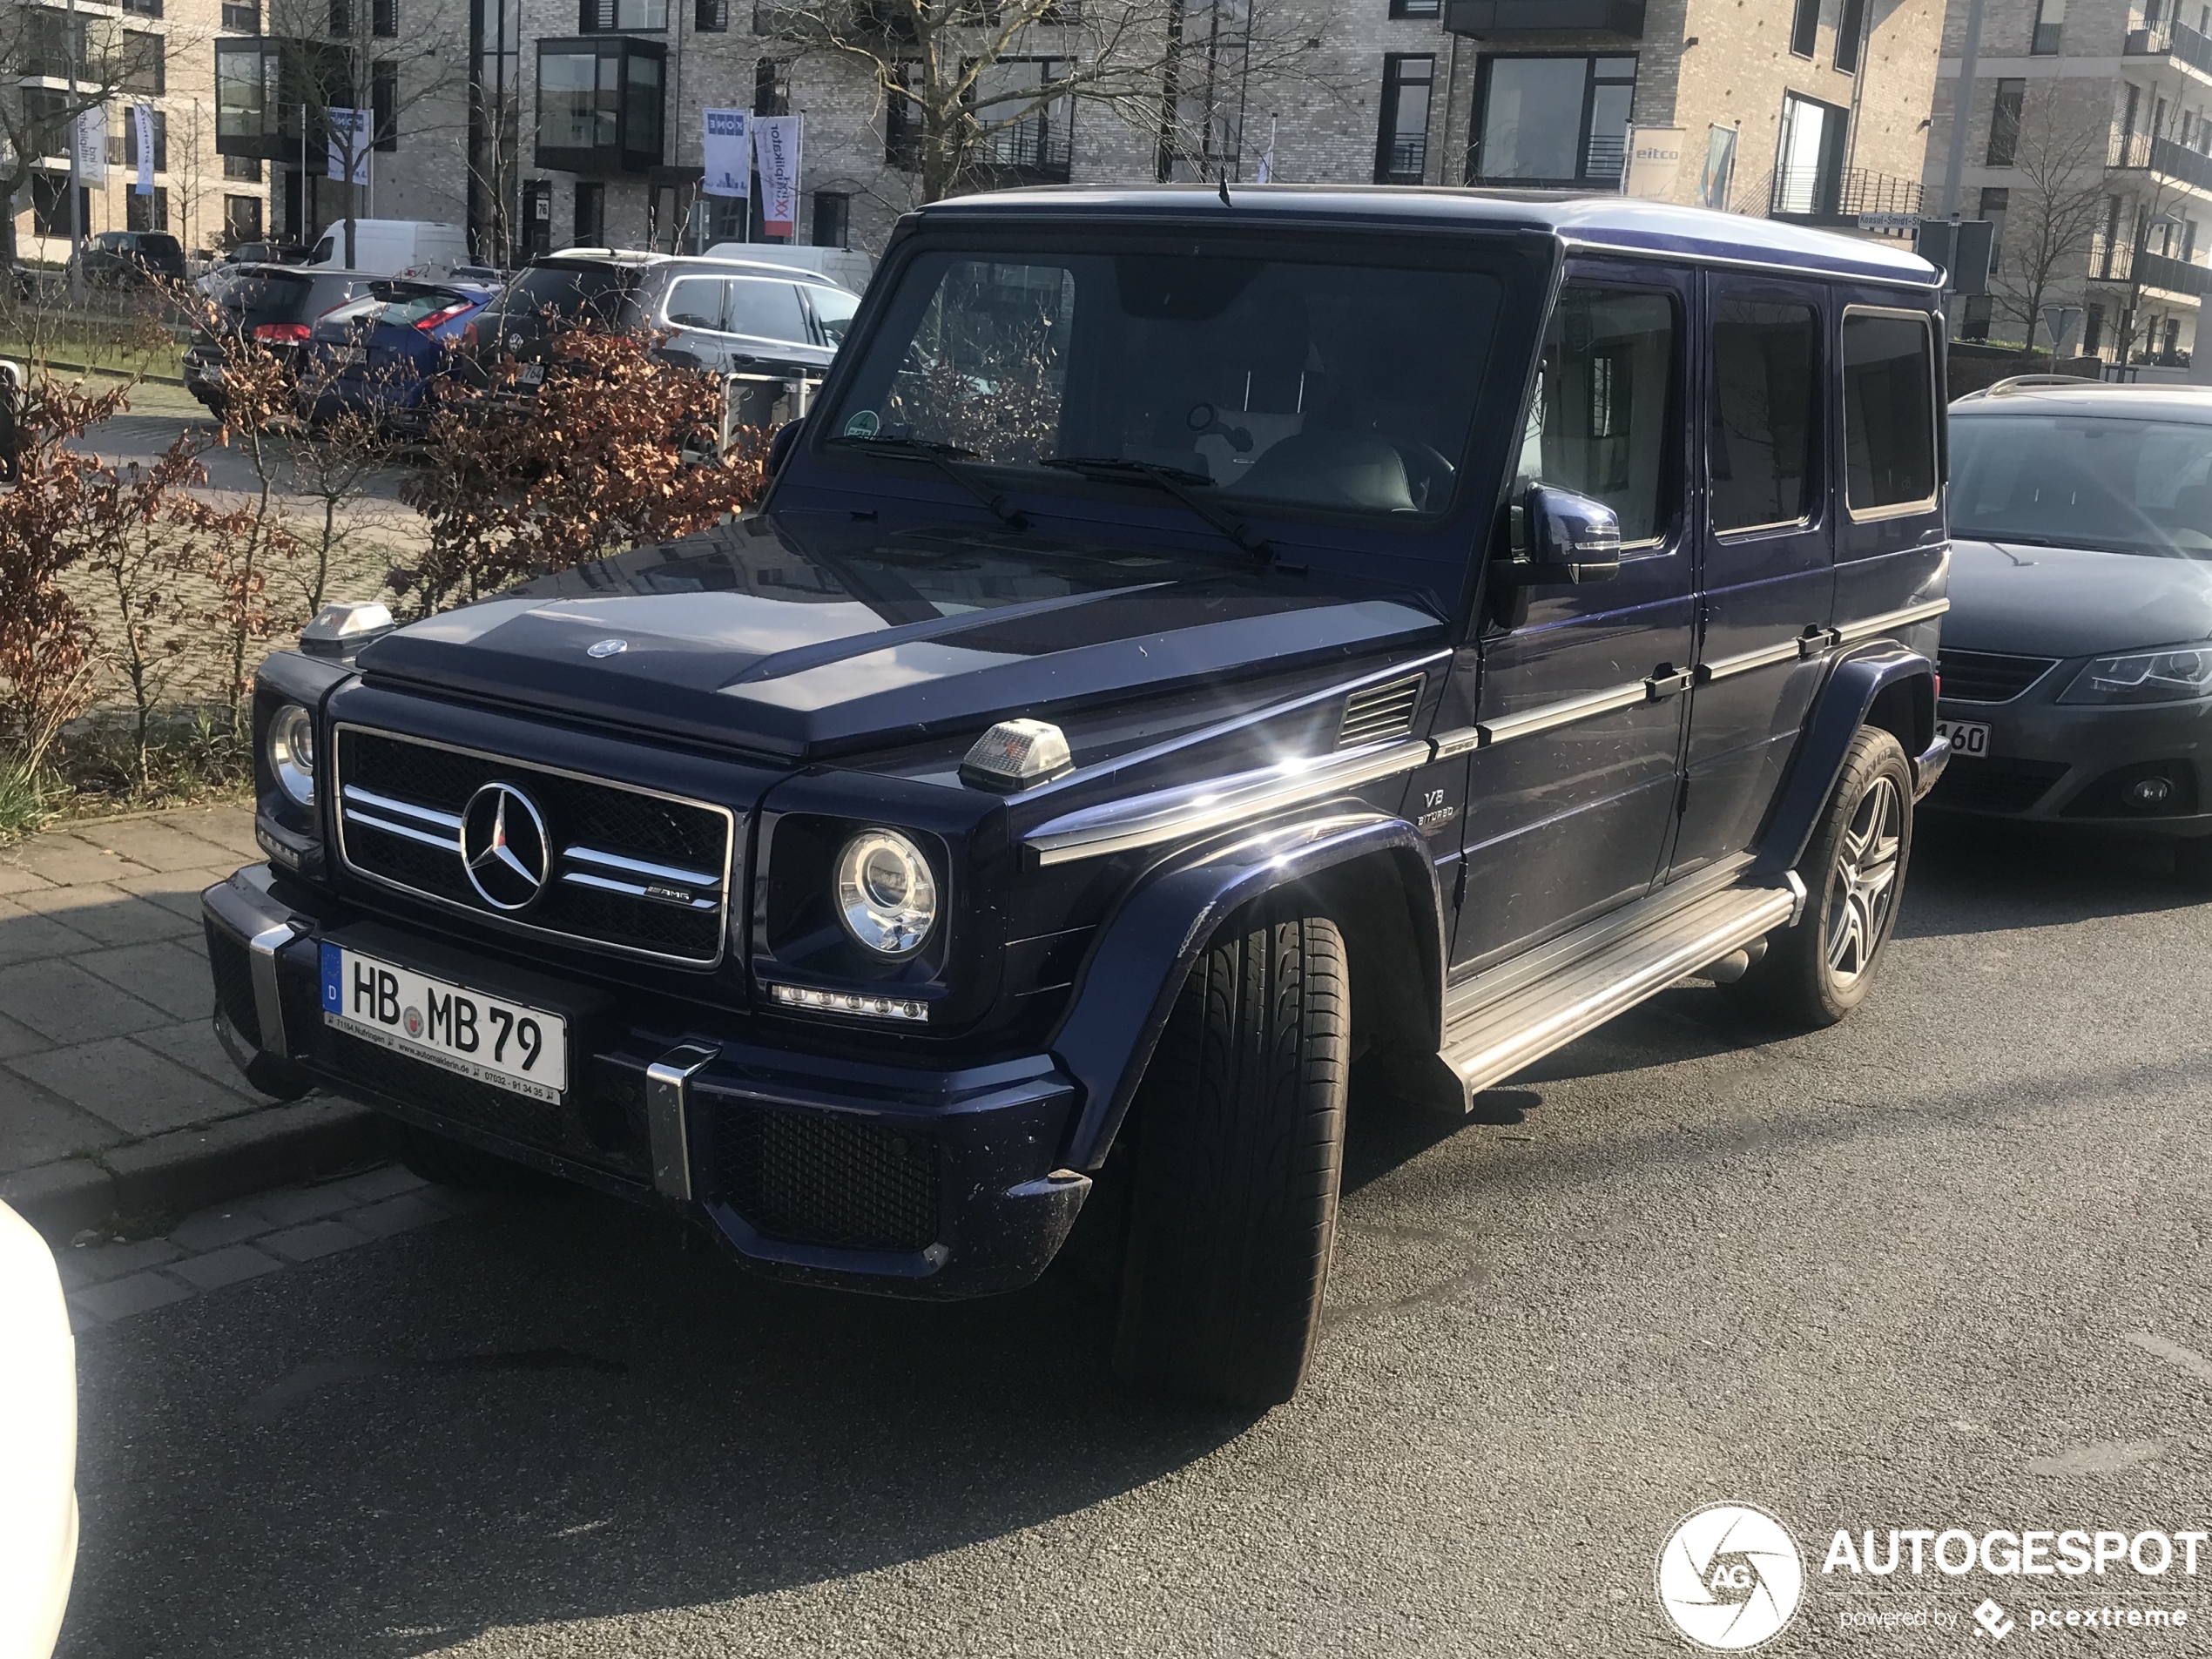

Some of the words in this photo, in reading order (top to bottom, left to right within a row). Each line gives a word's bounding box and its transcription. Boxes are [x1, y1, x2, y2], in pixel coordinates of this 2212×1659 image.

[1635, 147, 1679, 159] eitco
[538, 203, 548, 215] 76
[1424, 789, 1445, 808] V8
[1417, 806, 1453, 826] BITURBO
[661, 889, 690, 900] AMG
[328, 984, 337, 1001] D
[354, 961, 401, 1025] HB
[428, 987, 480, 1053] MB
[489, 1006, 543, 1071] 79
[484, 1072, 506, 1085] 07032
[512, 1081, 521, 1090] 91
[523, 1084, 532, 1094] 34
[533, 1087, 543, 1097] 35
